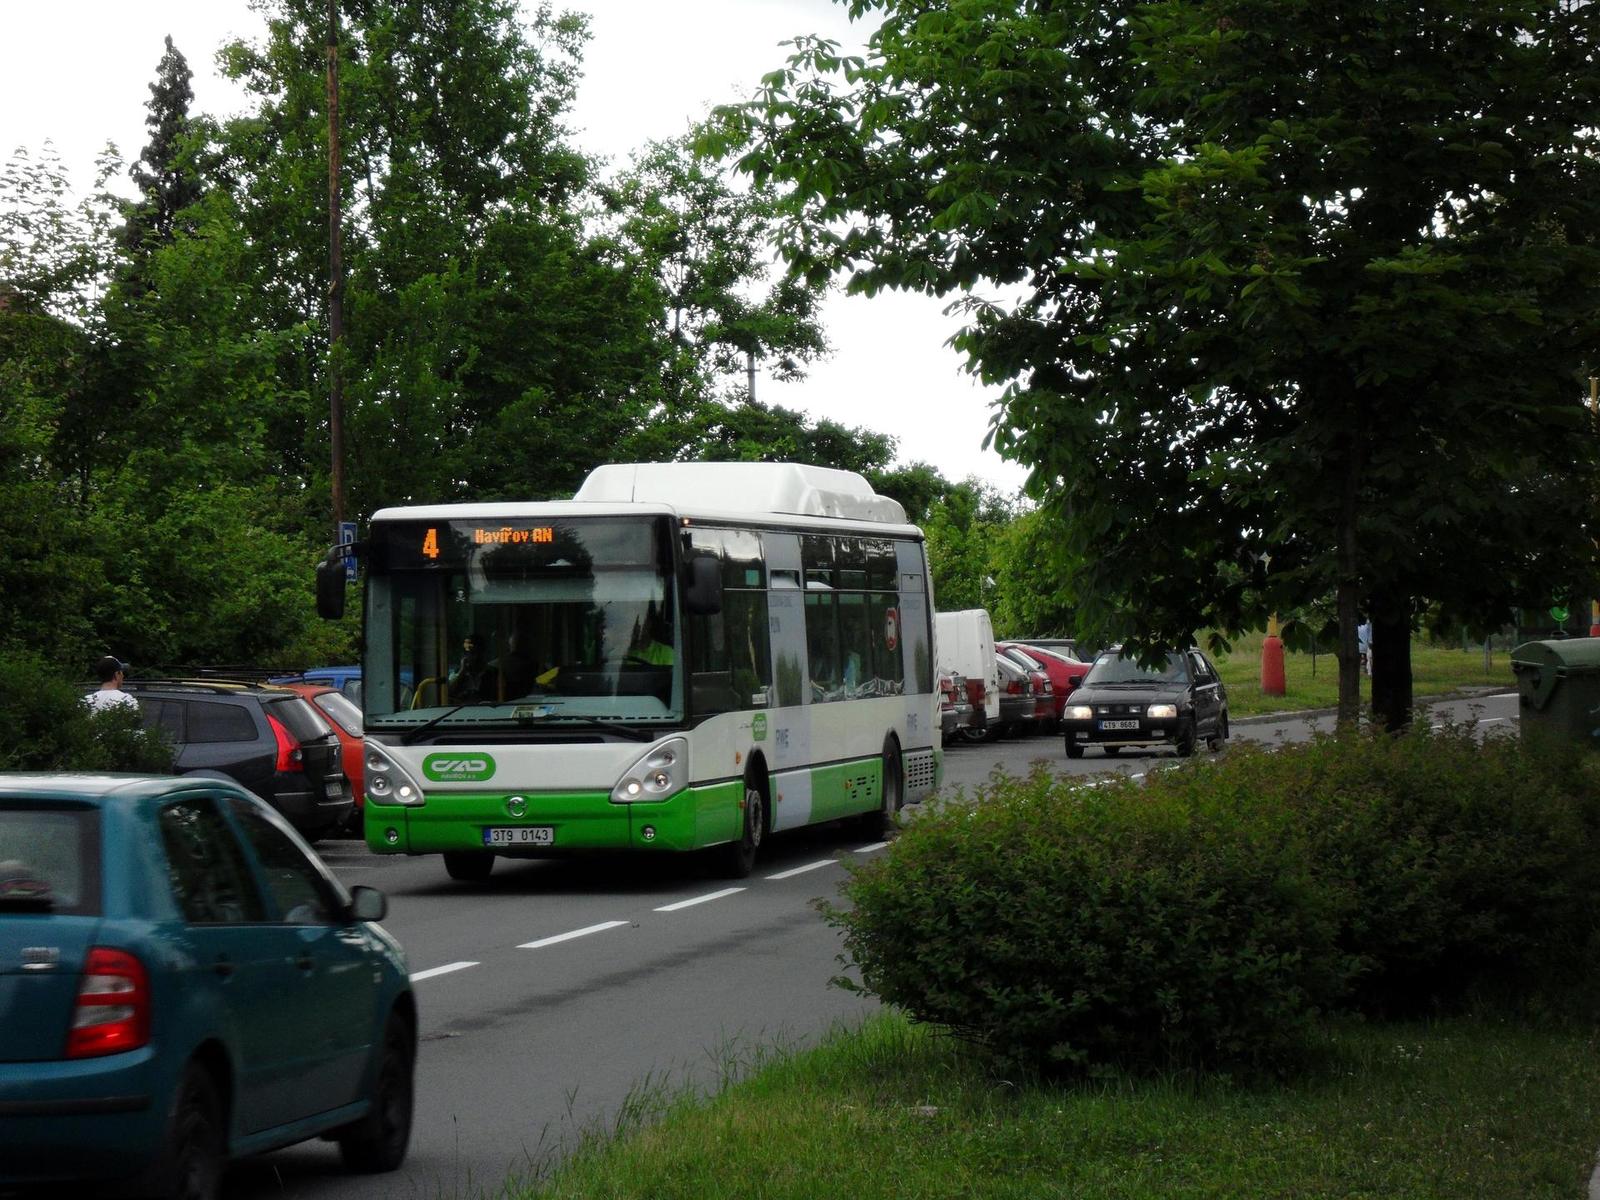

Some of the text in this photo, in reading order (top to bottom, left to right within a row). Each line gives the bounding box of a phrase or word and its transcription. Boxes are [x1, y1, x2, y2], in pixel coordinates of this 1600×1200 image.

[422, 528, 439, 558] 4
[532, 528, 553, 543] AN
[493, 829, 549, 841] 3T9 0143
